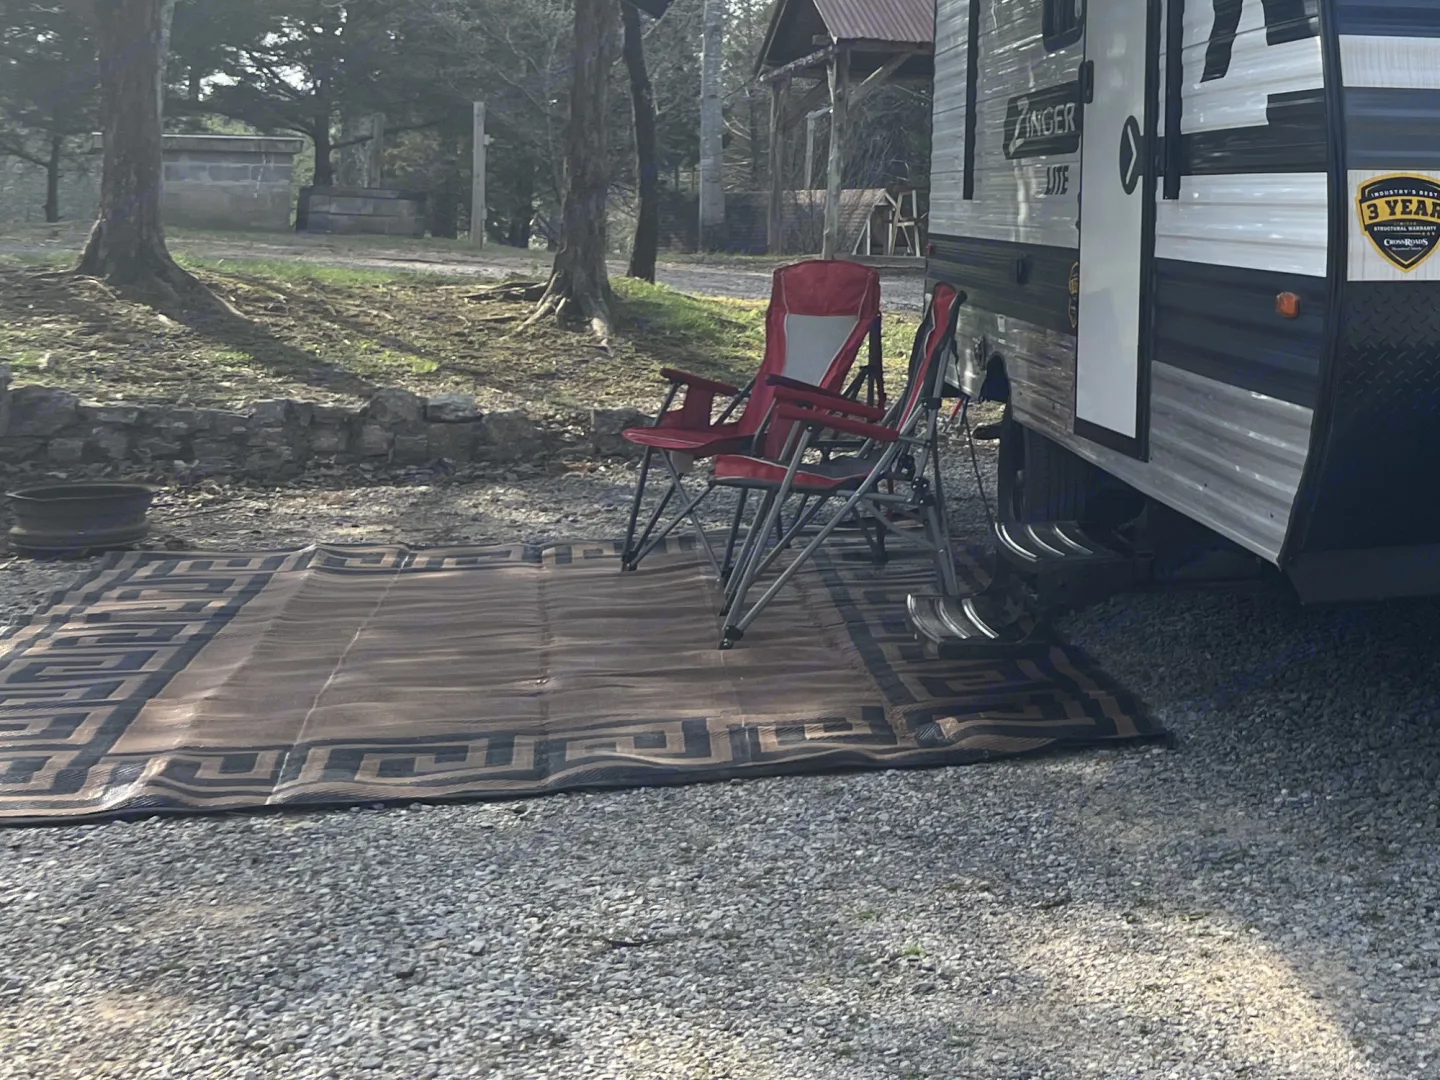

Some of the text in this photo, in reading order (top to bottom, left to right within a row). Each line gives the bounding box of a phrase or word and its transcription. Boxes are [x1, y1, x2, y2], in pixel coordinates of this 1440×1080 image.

[1008, 96, 1077, 157] ZINGER
[1044, 165, 1070, 196] LITE
[1366, 202, 1380, 221] 3
